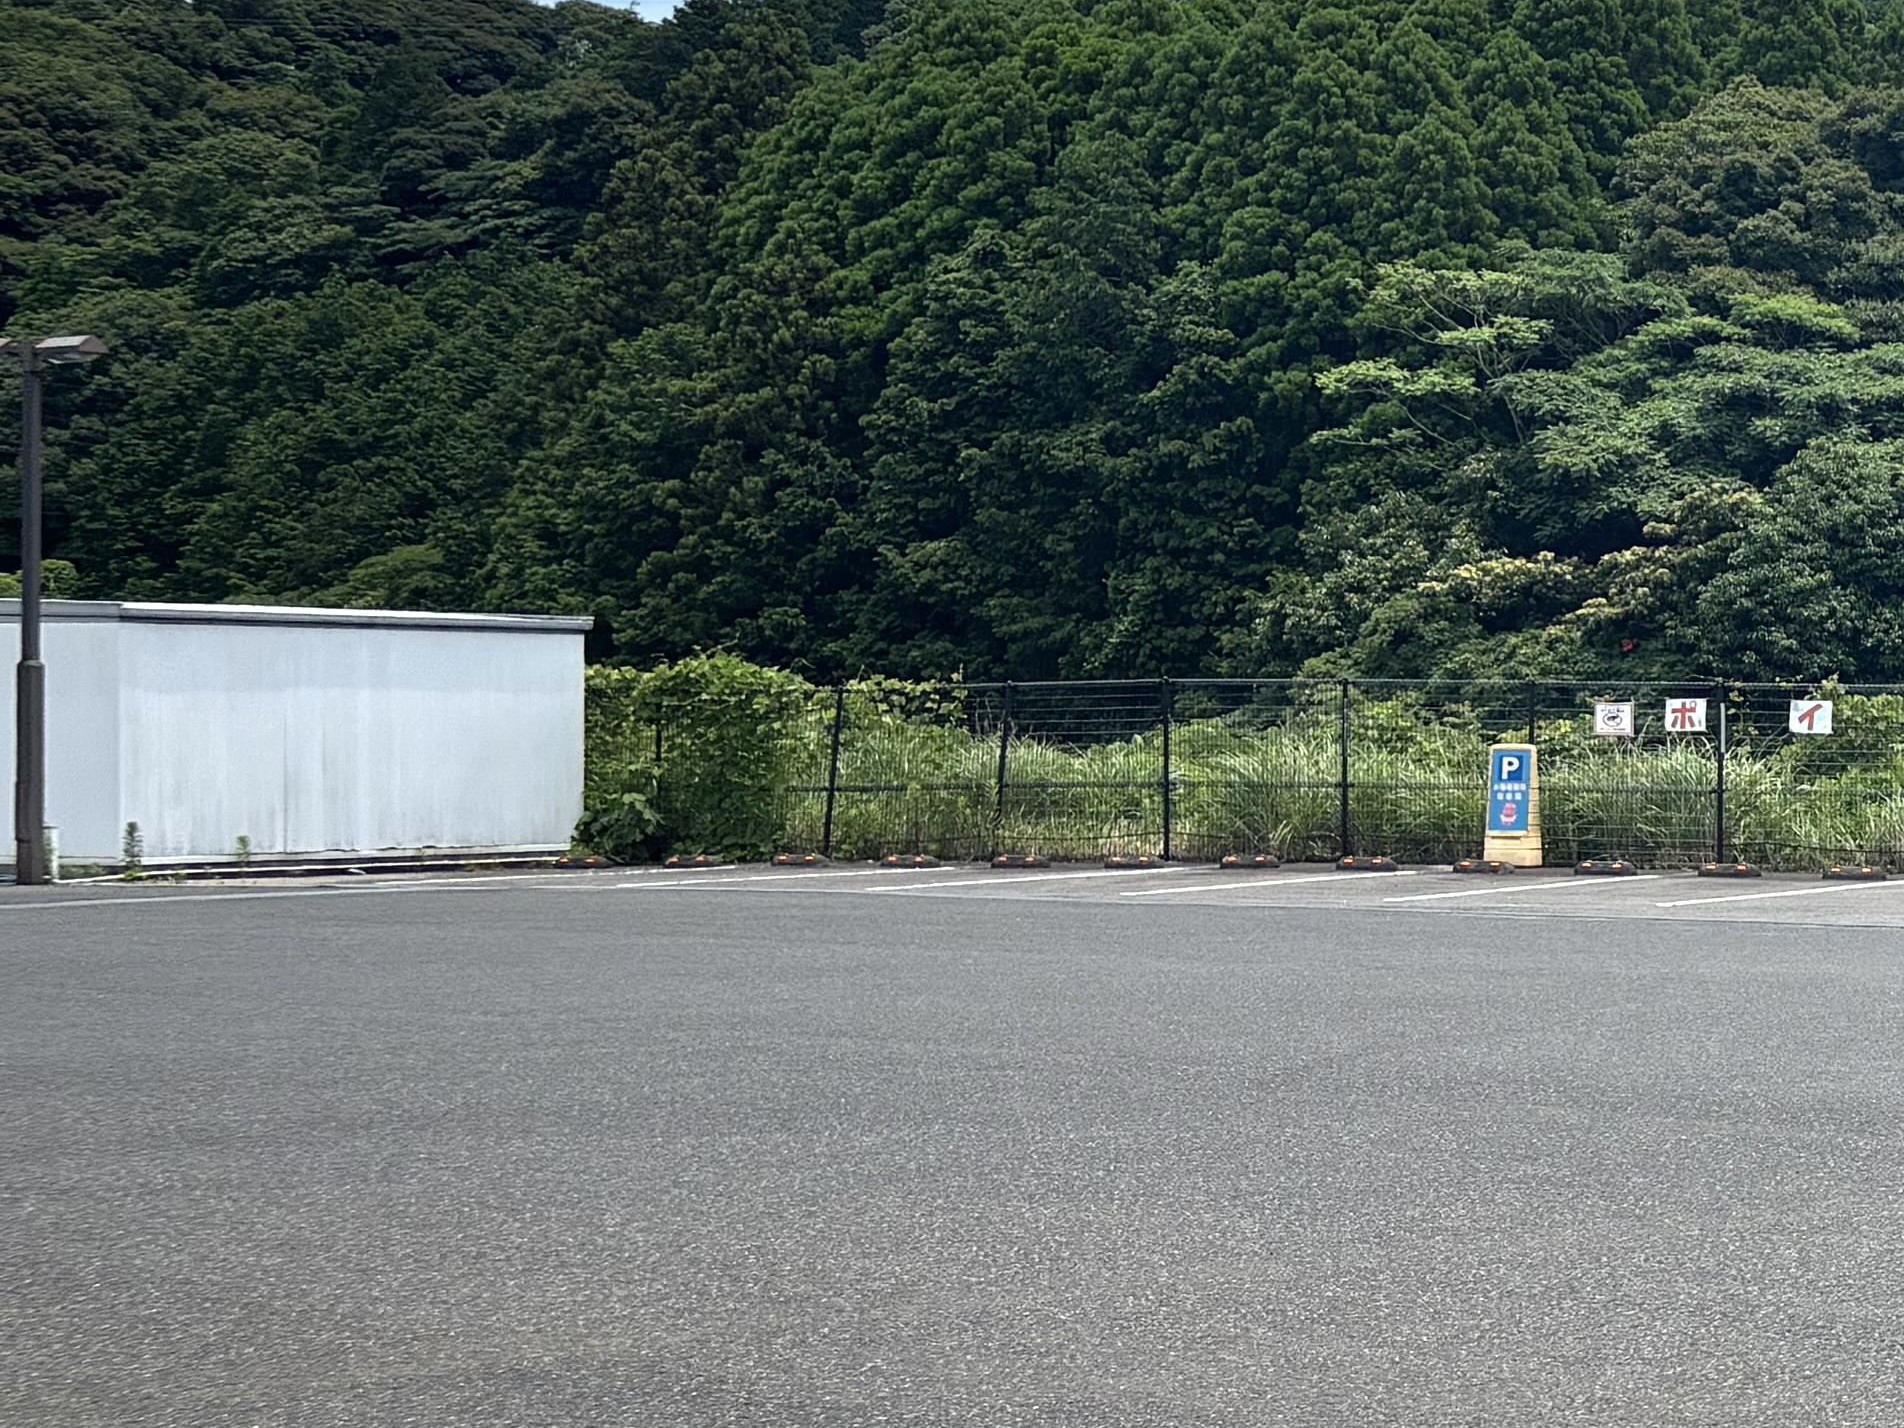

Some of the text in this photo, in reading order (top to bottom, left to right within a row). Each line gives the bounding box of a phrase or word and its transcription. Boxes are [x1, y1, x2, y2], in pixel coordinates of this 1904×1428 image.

[1671, 700, 1698, 729] ポ
[1797, 703, 1823, 731] イ
[1501, 756, 1520, 780] P
